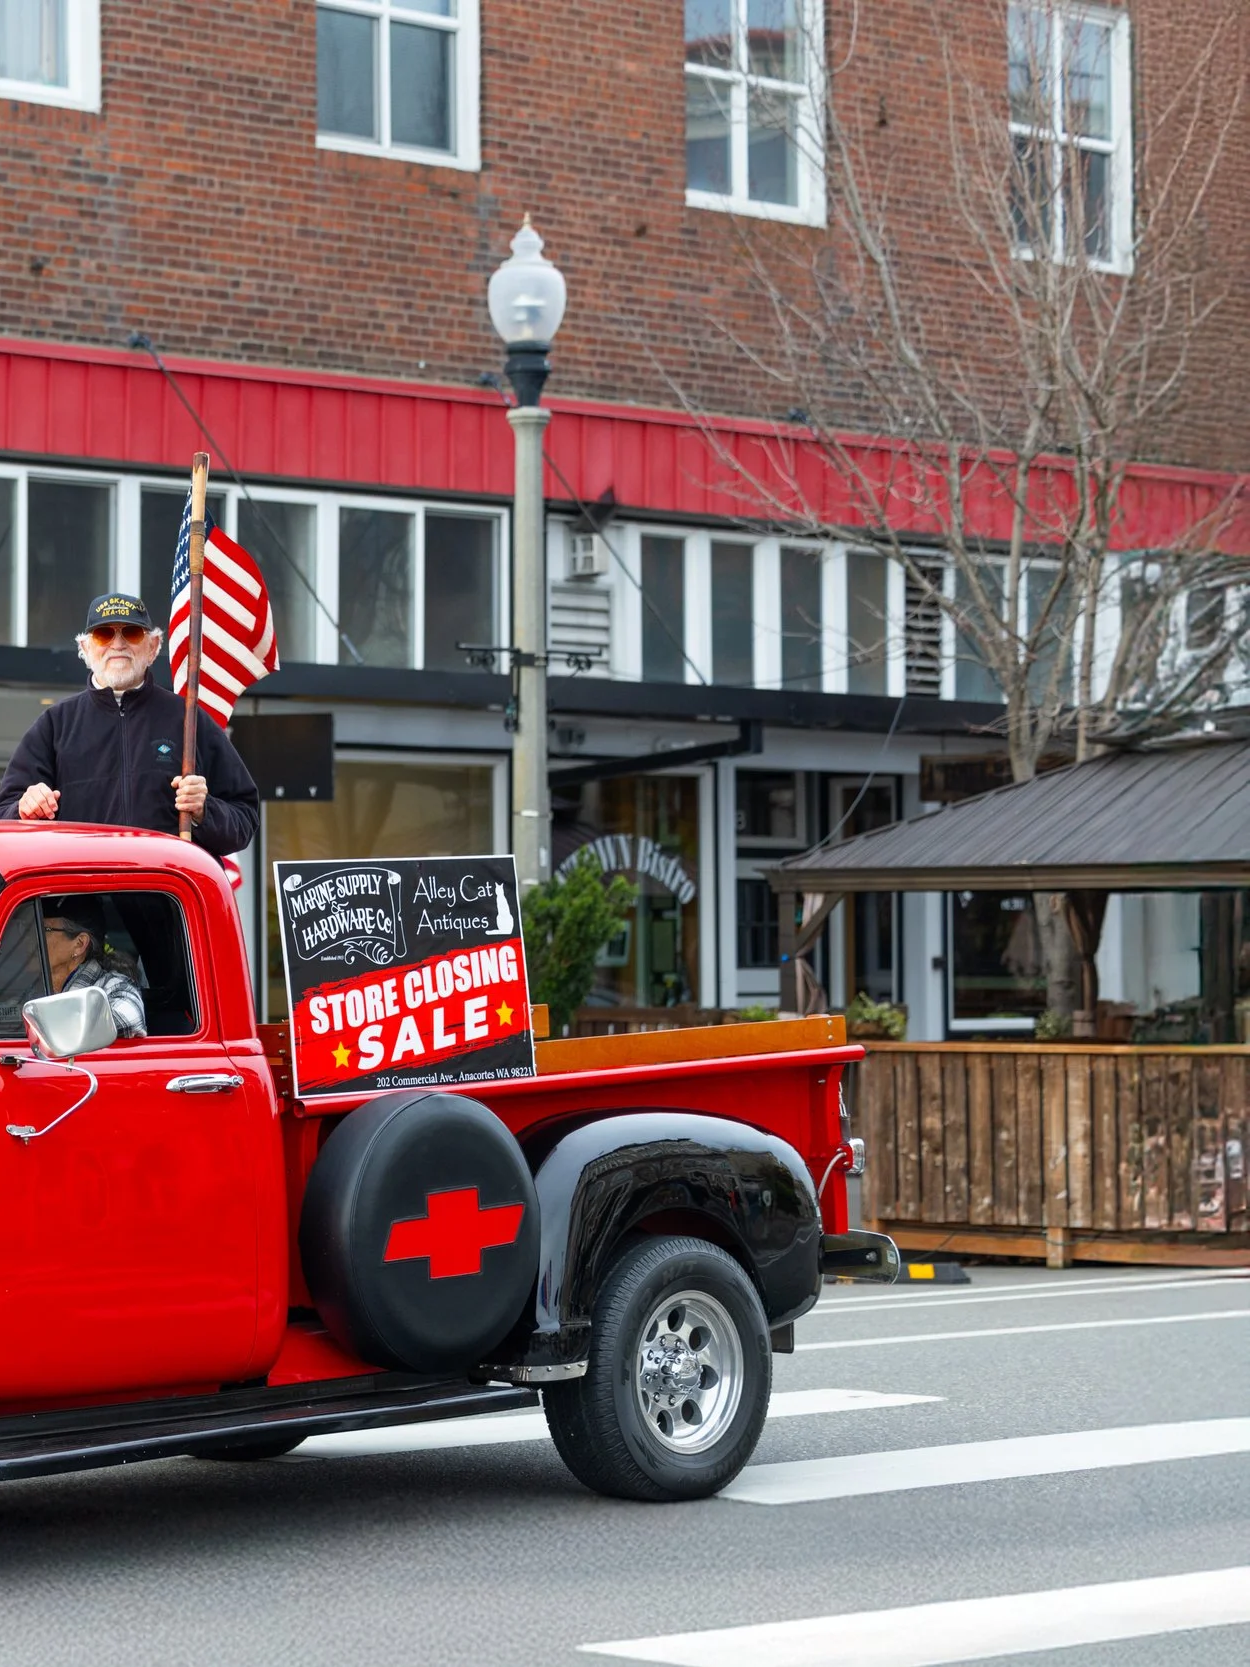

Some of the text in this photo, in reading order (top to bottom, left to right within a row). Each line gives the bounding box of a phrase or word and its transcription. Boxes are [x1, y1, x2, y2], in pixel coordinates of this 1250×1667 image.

[95, 597, 137, 613] USS SKAGIT
[101, 609, 130, 618] AKA-105
[637, 836, 695, 904] Bistro
[290, 874, 382, 918] MARINE SUPPLY
[413, 874, 493, 907] Alley Cat
[302, 908, 393, 951] HARDWARE Co.
[416, 909, 489, 940] Antiques
[309, 945, 519, 1034] STORE CLOSING
[357, 995, 489, 1070] SALE
[376, 1077, 391, 1088] 202
[391, 1072, 438, 1086] Commercial
[458, 1069, 495, 1081] Anacortes
[495, 1068, 510, 1078] WA
[510, 1066, 533, 1077] 98221
